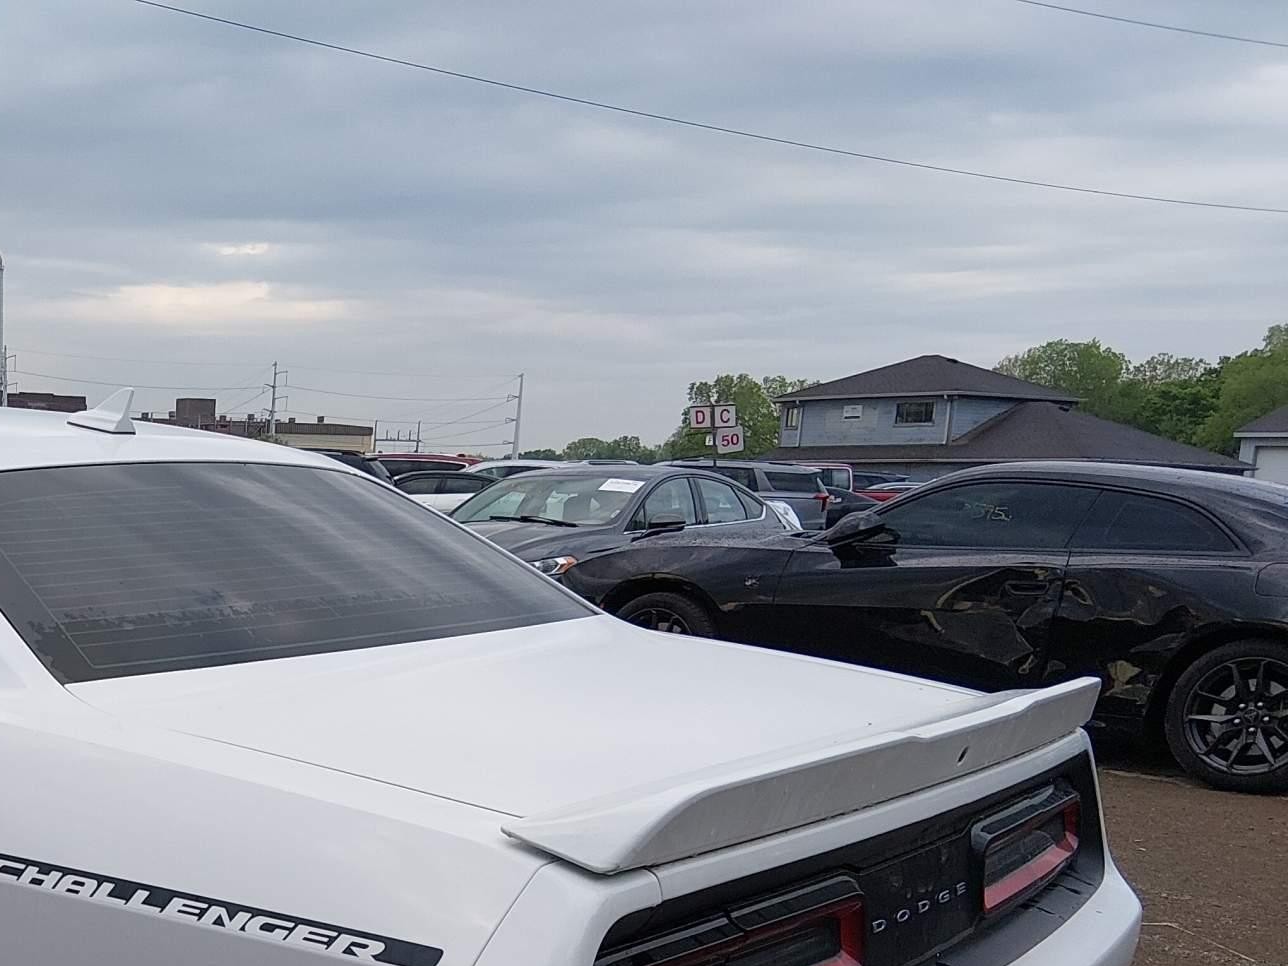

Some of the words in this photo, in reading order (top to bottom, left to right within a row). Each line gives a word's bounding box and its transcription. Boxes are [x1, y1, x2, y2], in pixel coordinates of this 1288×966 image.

[695, 410, 706, 425] D
[720, 408, 730, 424] C
[721, 433, 740, 448] 50
[872, 881, 968, 934] DODGE
